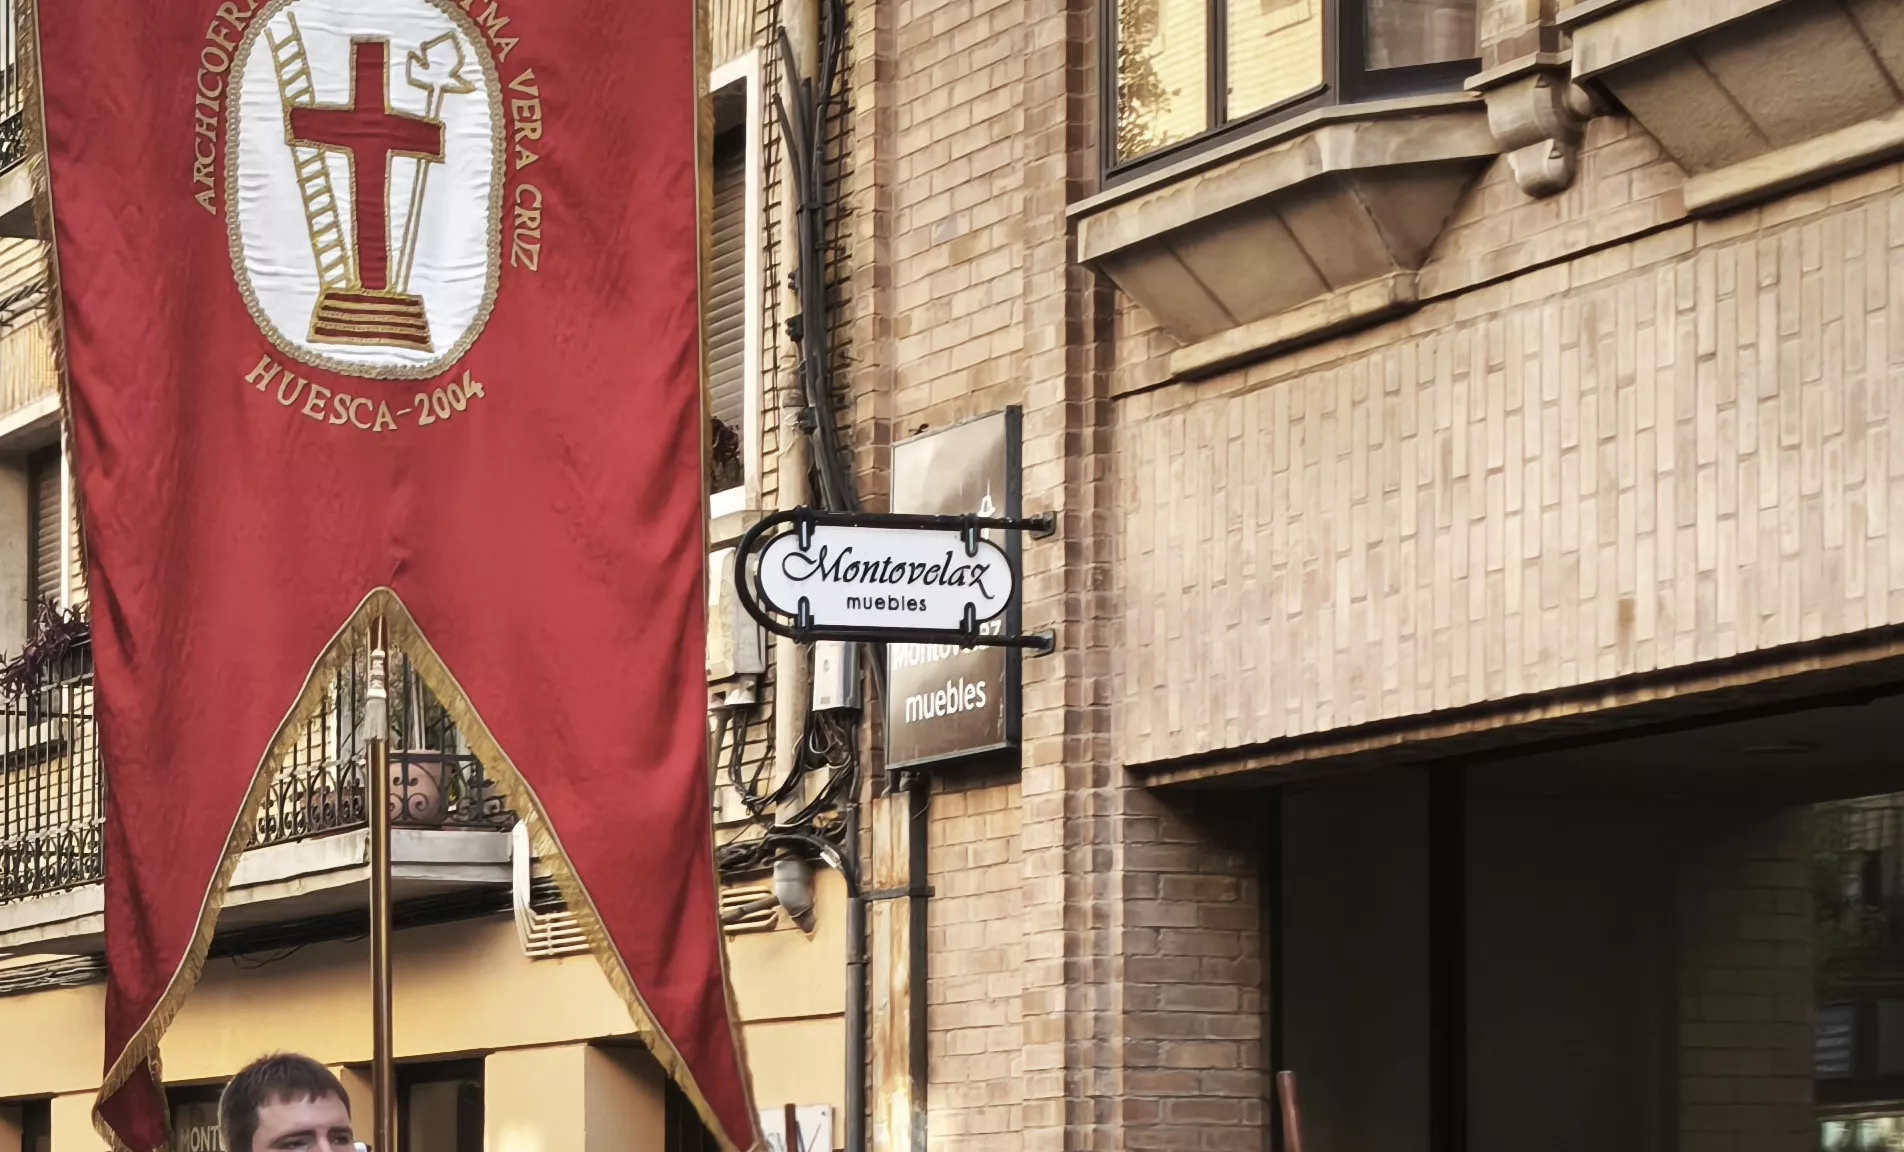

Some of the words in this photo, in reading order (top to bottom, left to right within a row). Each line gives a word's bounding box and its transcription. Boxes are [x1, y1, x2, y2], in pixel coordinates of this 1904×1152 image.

[193, 0, 258, 216] ARCHICOFR
[508, 68, 543, 170] VERA
[510, 184, 543, 271] CRUZ
[781, 545, 995, 600] Montovelaz
[846, 595, 928, 612] muebles
[905, 677, 987, 724] muebles
